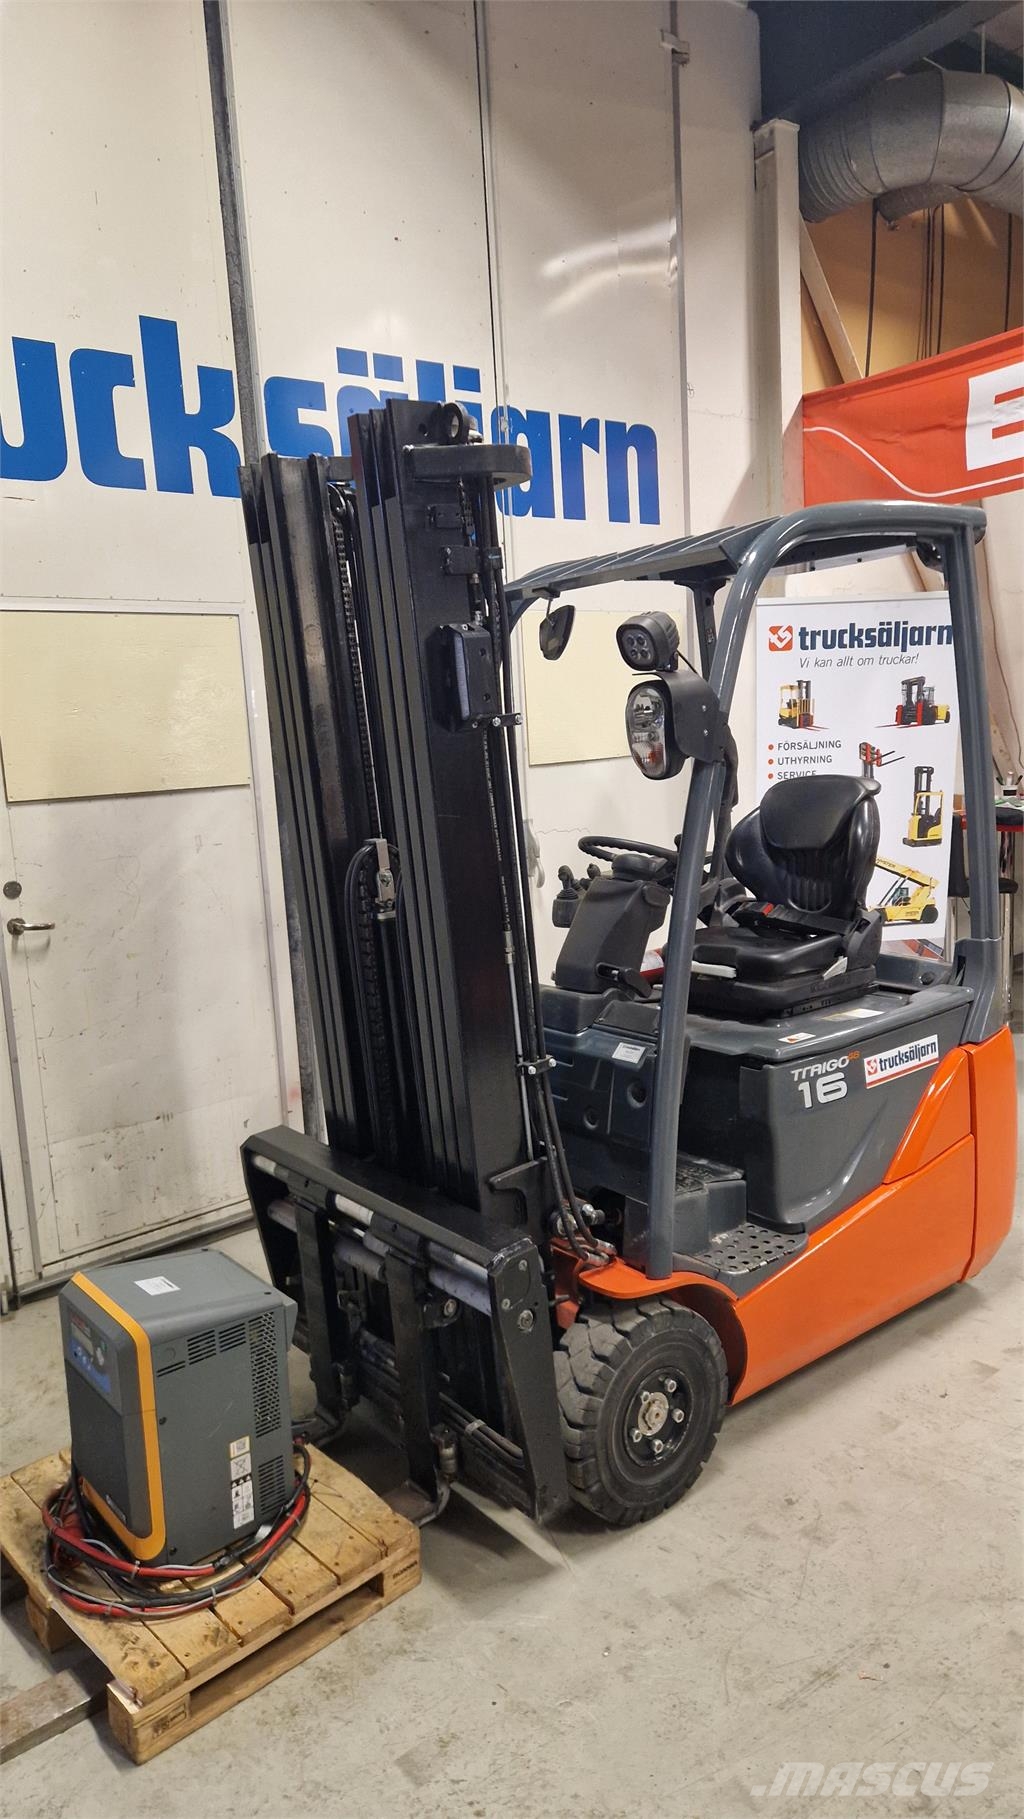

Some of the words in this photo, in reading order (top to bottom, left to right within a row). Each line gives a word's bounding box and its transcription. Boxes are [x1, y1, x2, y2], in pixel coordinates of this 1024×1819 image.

[799, 621, 953, 653] trucksäljarn
[799, 657, 810, 668] Vi
[813, 657, 833, 668] kan
[836, 655, 854, 667] allt
[856, 657, 874, 667] om
[878, 653, 919, 666] truckar!
[777, 739, 842, 751] FÖRSÄLJNING
[777, 754, 833, 766] UTHYRNING
[878, 1041, 937, 1072] trucksäljarn
[798, 1072, 848, 1108] 16
